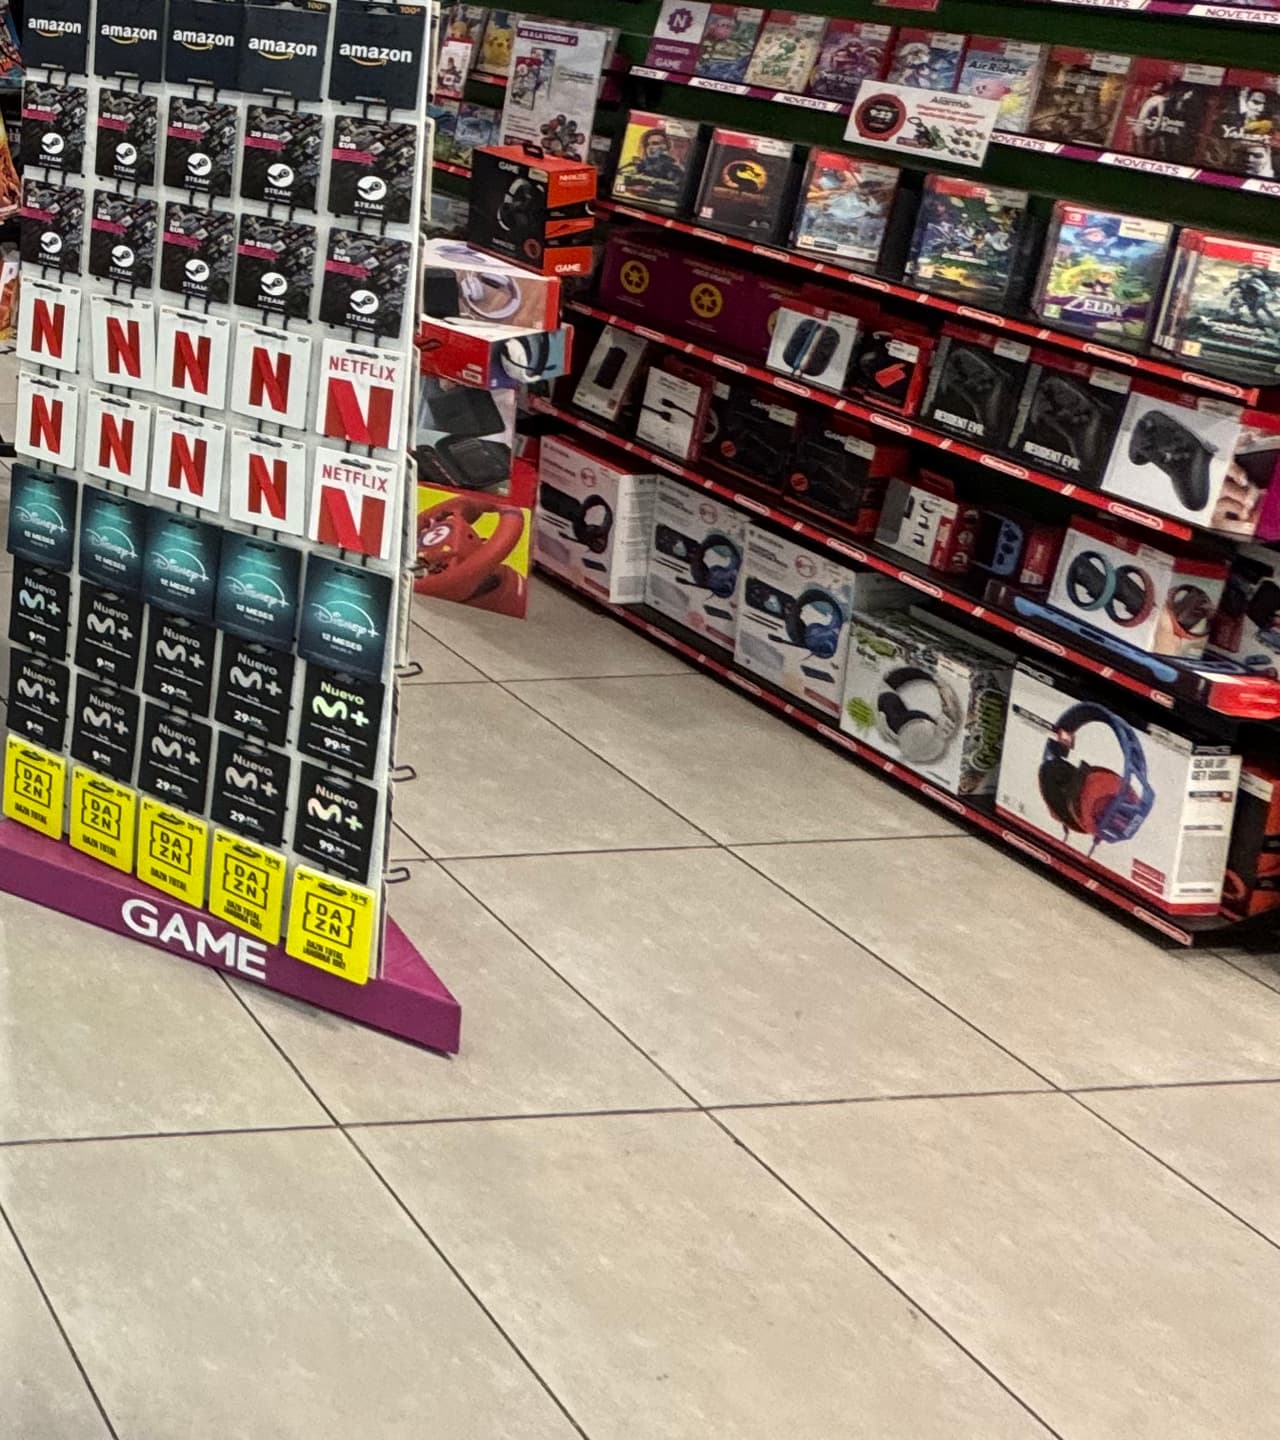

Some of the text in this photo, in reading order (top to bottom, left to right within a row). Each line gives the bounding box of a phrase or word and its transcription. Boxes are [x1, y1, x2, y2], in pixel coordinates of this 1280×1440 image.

[1206, 7, 1278, 23] NOVETATS
[173, 29, 235, 48] amazon
[340, 43, 413, 62] amazon
[783, 95, 833, 110] NOVETATS
[1114, 155, 1180, 175] NOVETATS
[32, 299, 65, 359] N
[108, 317, 141, 378] N
[172, 332, 210, 395] N
[329, 356, 395, 383] NETFLIX
[249, 347, 291, 414] N
[322, 465, 388, 493] NETFLIX
[24, 576, 58, 597] Nuevo
[162, 626, 200, 648] Nuevo
[322, 681, 365, 705] Nuevo
[316, 783, 358, 809] Nuevo
[121, 898, 267, 980] GAME
